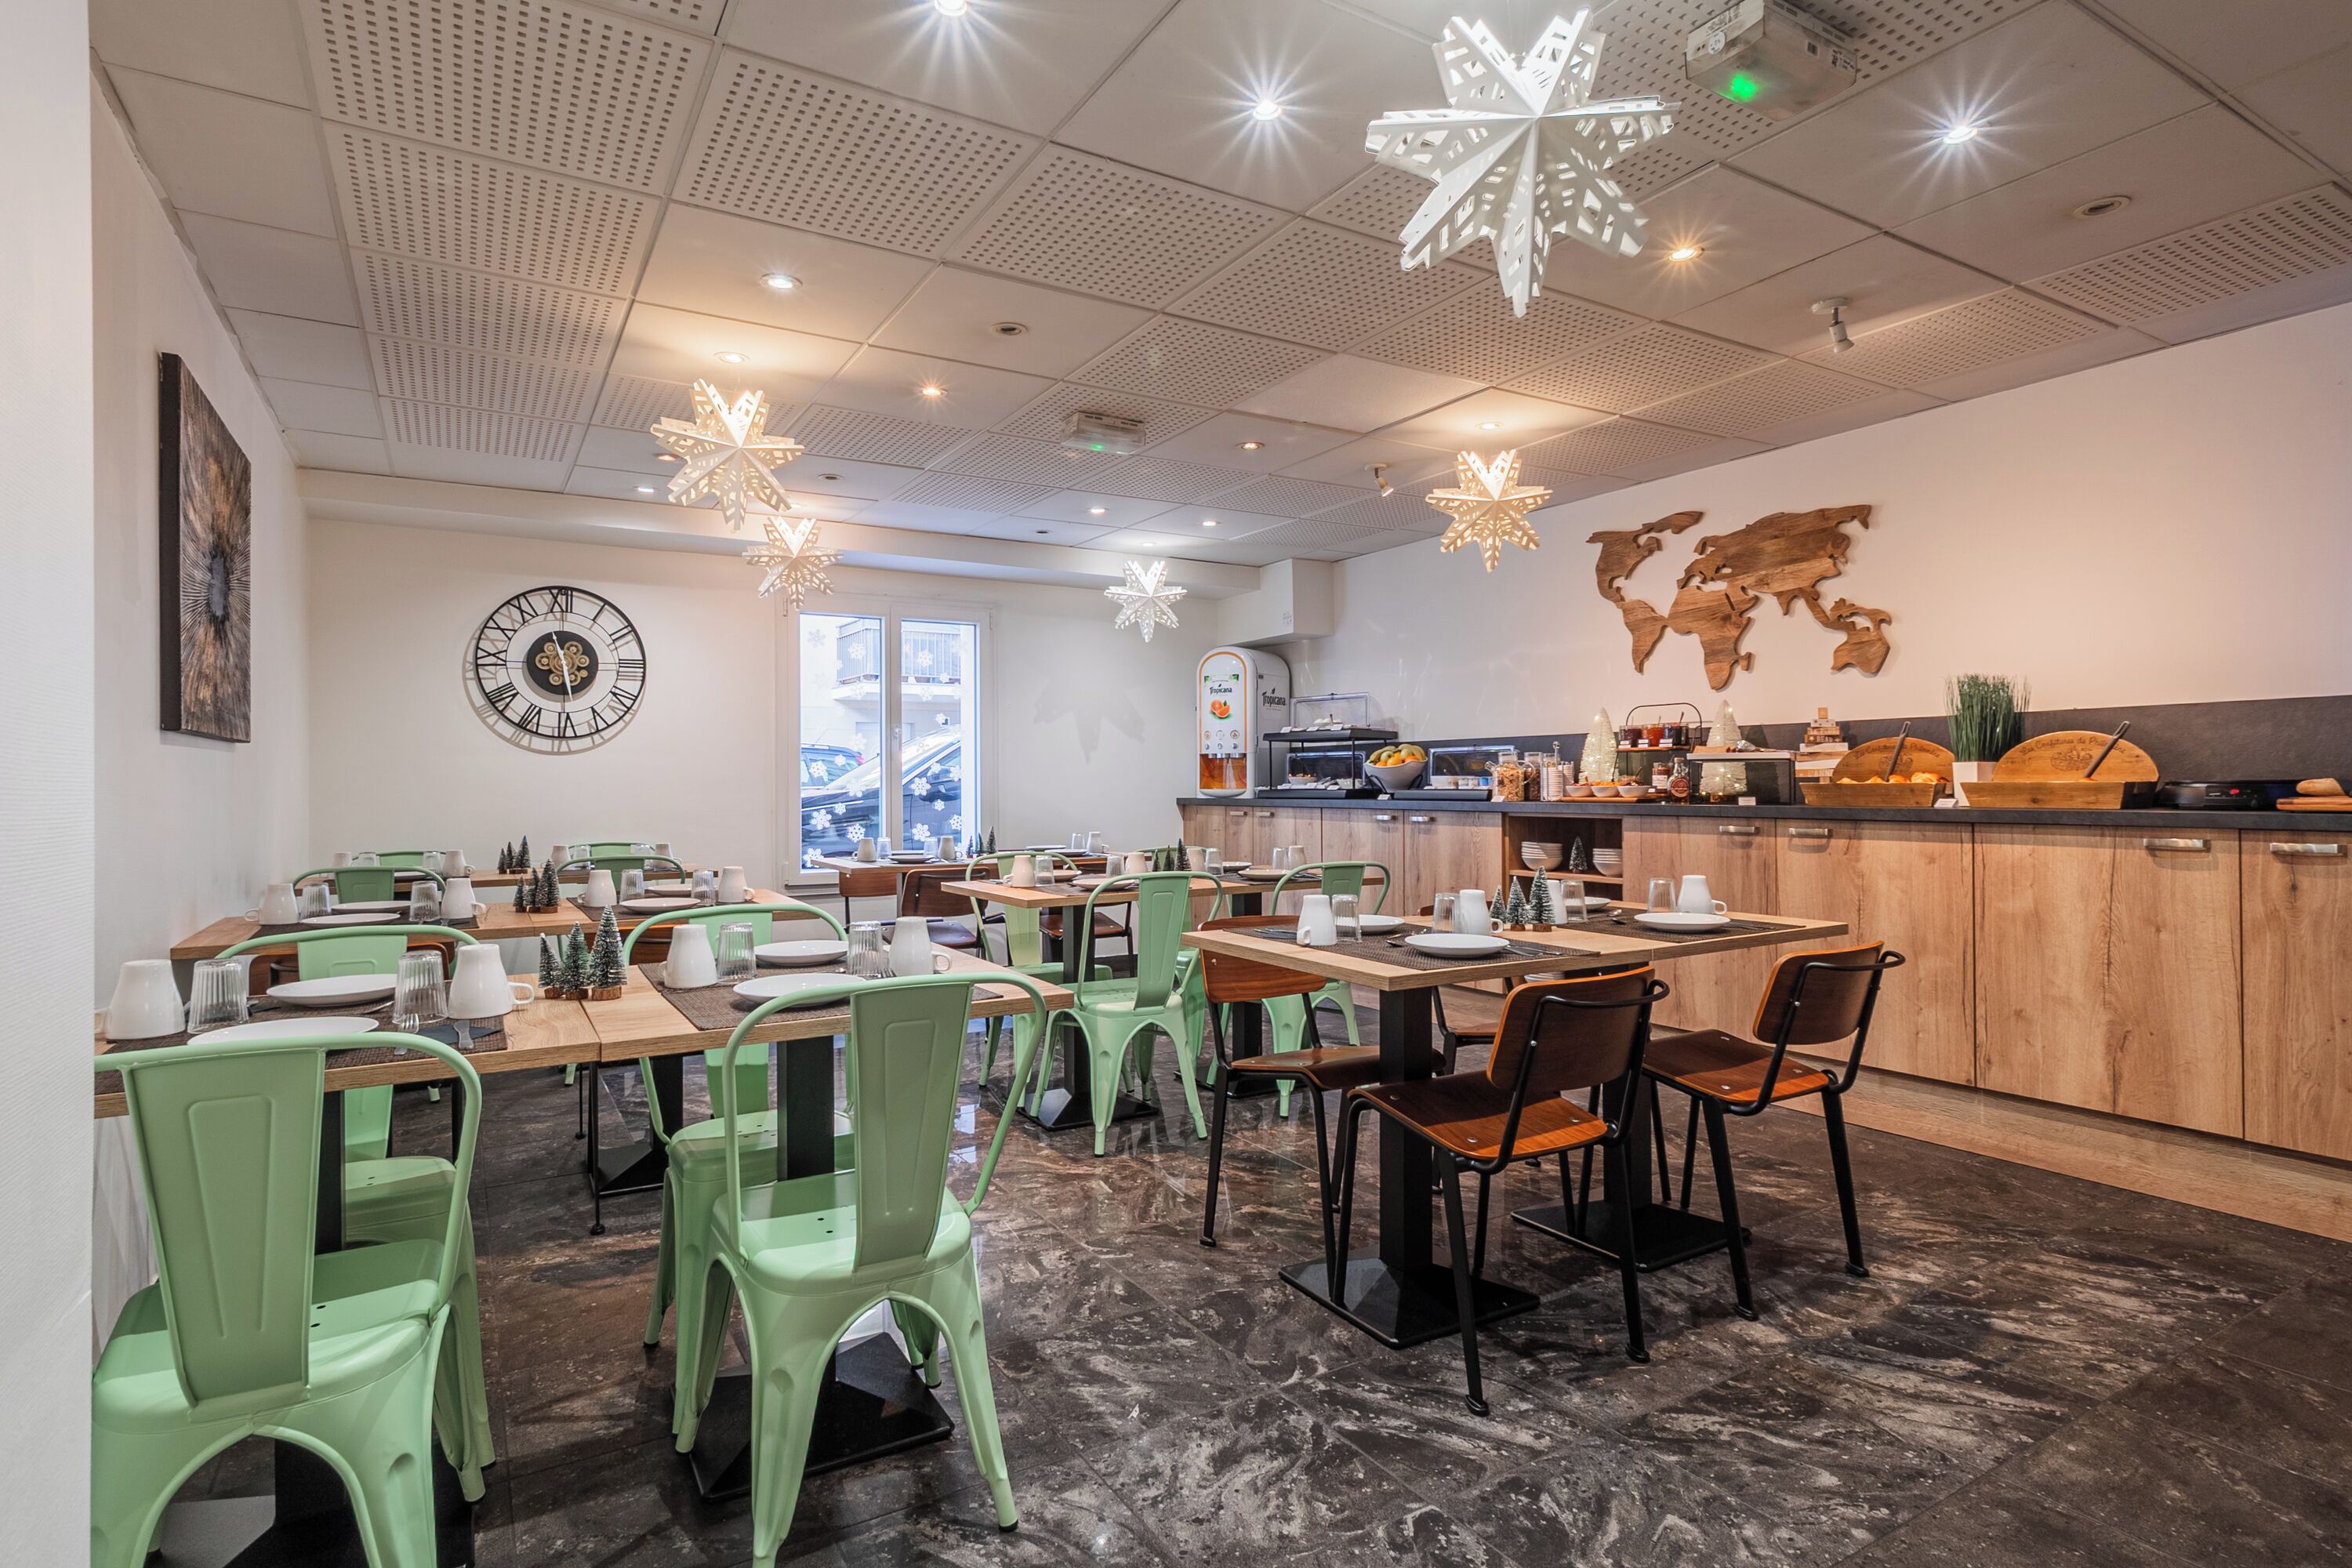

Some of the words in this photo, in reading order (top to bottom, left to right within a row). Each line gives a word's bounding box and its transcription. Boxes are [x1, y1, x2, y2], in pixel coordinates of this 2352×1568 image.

[1209, 686, 1232, 695] Tropicana
[1261, 691, 1286, 707] Tropicana
[2035, 739, 2074, 750] Confitures
